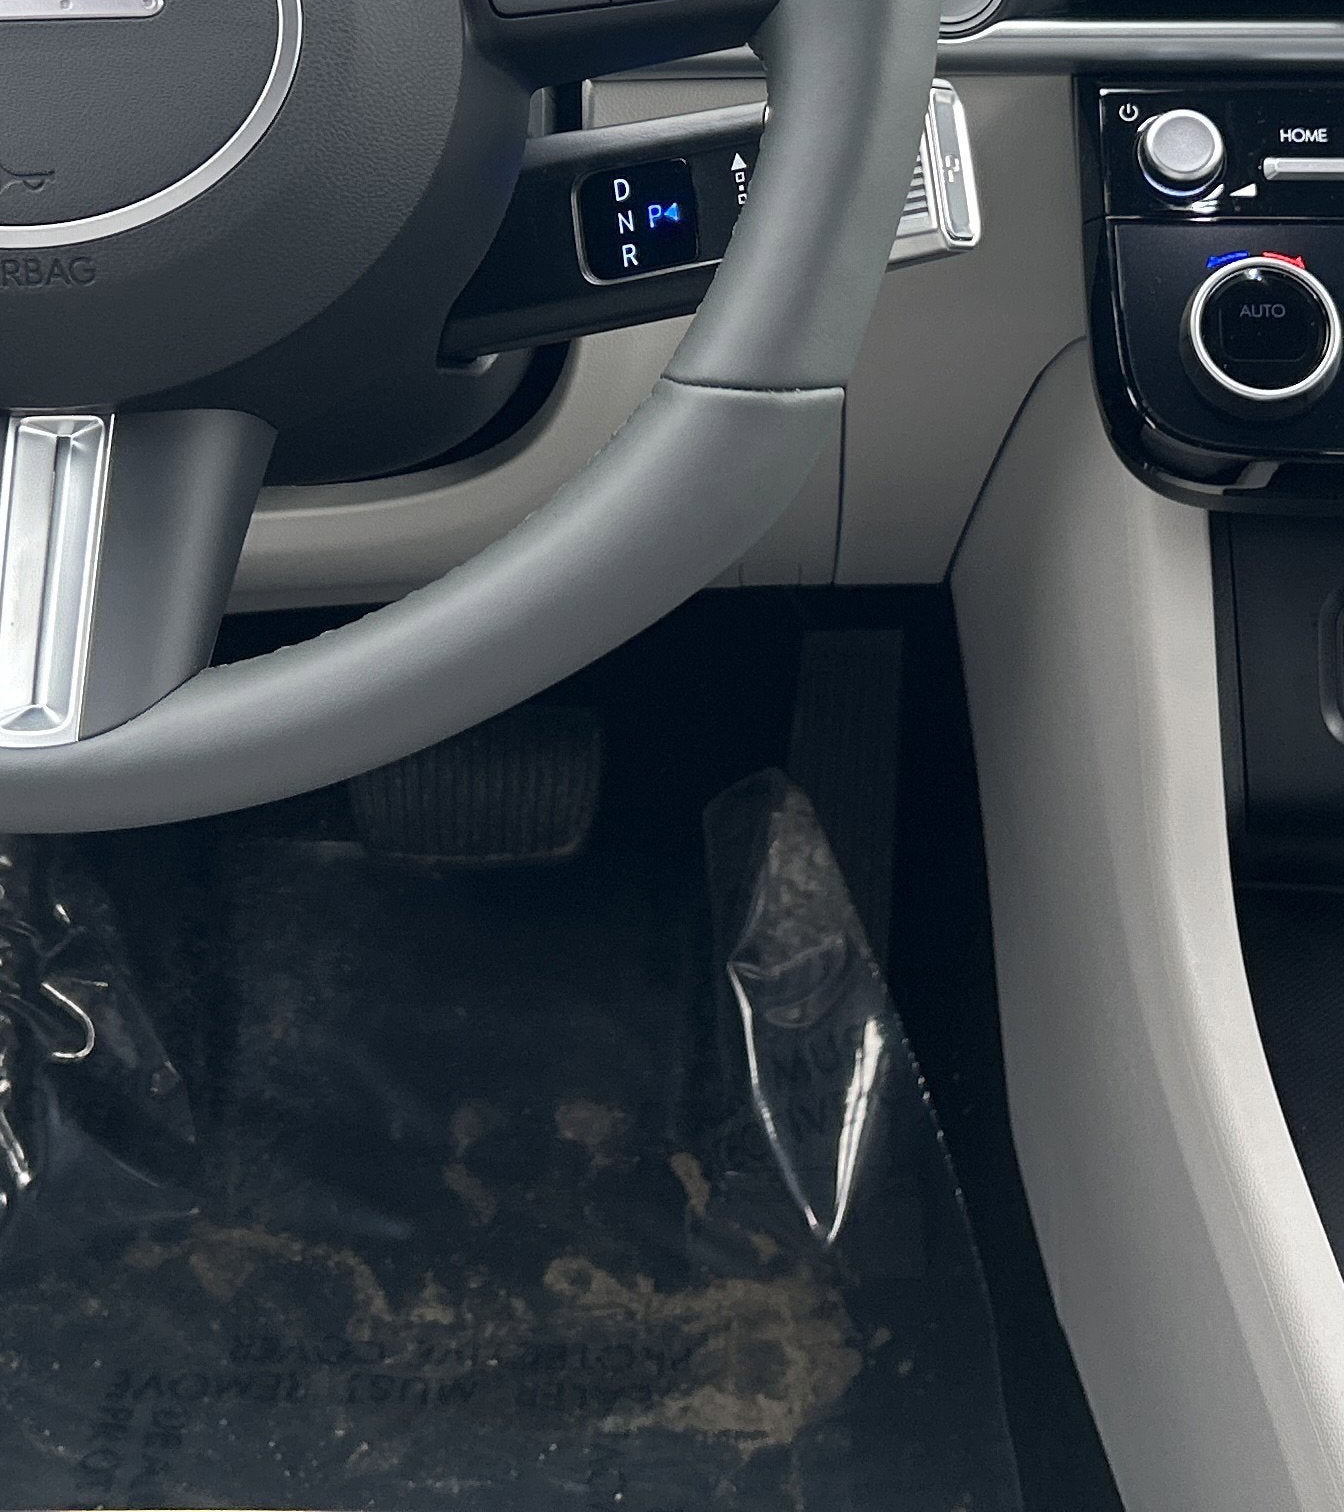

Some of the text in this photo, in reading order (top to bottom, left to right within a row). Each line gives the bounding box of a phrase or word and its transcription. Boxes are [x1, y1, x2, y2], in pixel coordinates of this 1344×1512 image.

[1280, 128, 1327, 142] HOME
[614, 179, 629, 201] D
[618, 210, 634, 234] N
[648, 205, 662, 228] P
[622, 244, 638, 267] R
[1240, 304, 1285, 318] AUTO
